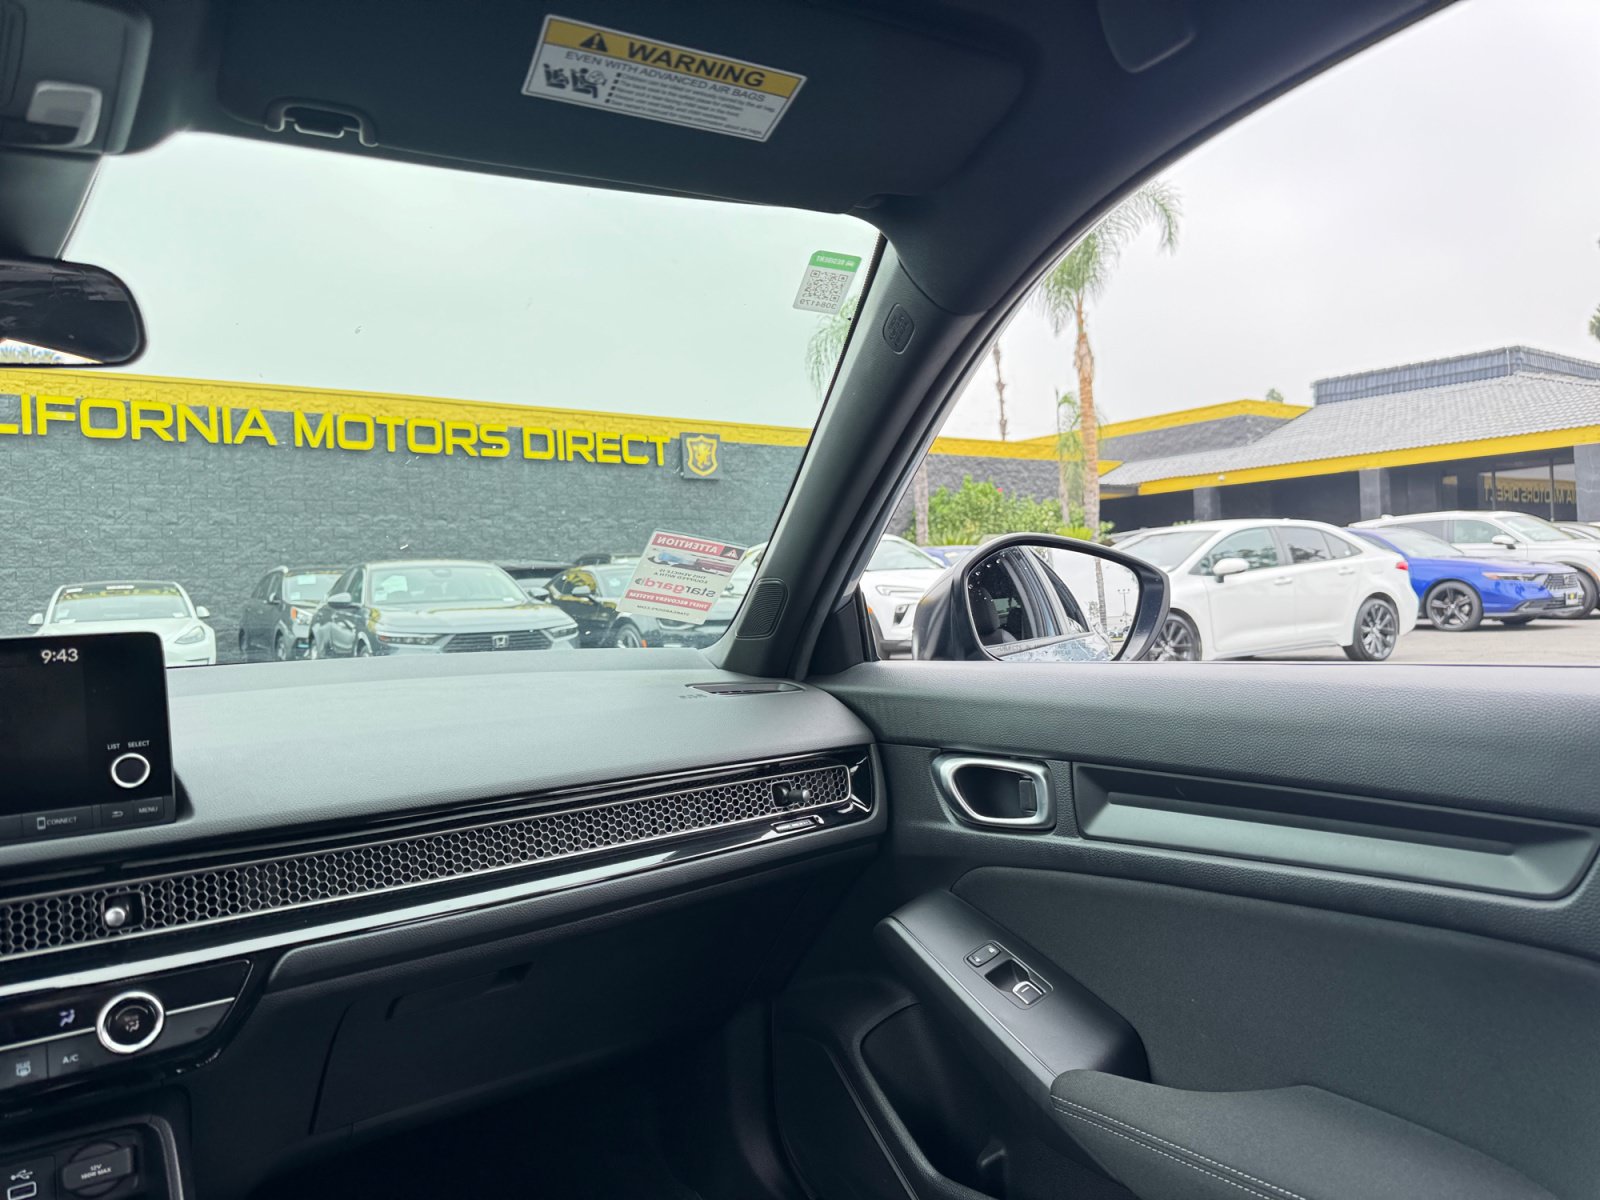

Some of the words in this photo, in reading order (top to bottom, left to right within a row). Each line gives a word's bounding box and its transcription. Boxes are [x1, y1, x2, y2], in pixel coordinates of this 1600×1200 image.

[627, 41, 766, 88] WARNING
[565, 51, 602, 67] EVEN
[604, 58, 640, 76] WITH
[640, 66, 708, 91] ADVANCED
[709, 82, 731, 95] AIR
[732, 87, 766, 103] BAGS
[294, 410, 511, 457] MOTORS
[522, 427, 671, 466] DIRECT
[41, 648, 79, 664] 9:43
[107, 743, 120, 751] LIST
[127, 740, 150, 748] SELECT
[138, 805, 159, 815] MENU
[46, 816, 78, 826] CONNECT
[62, 1053, 79, 1065] A/C
